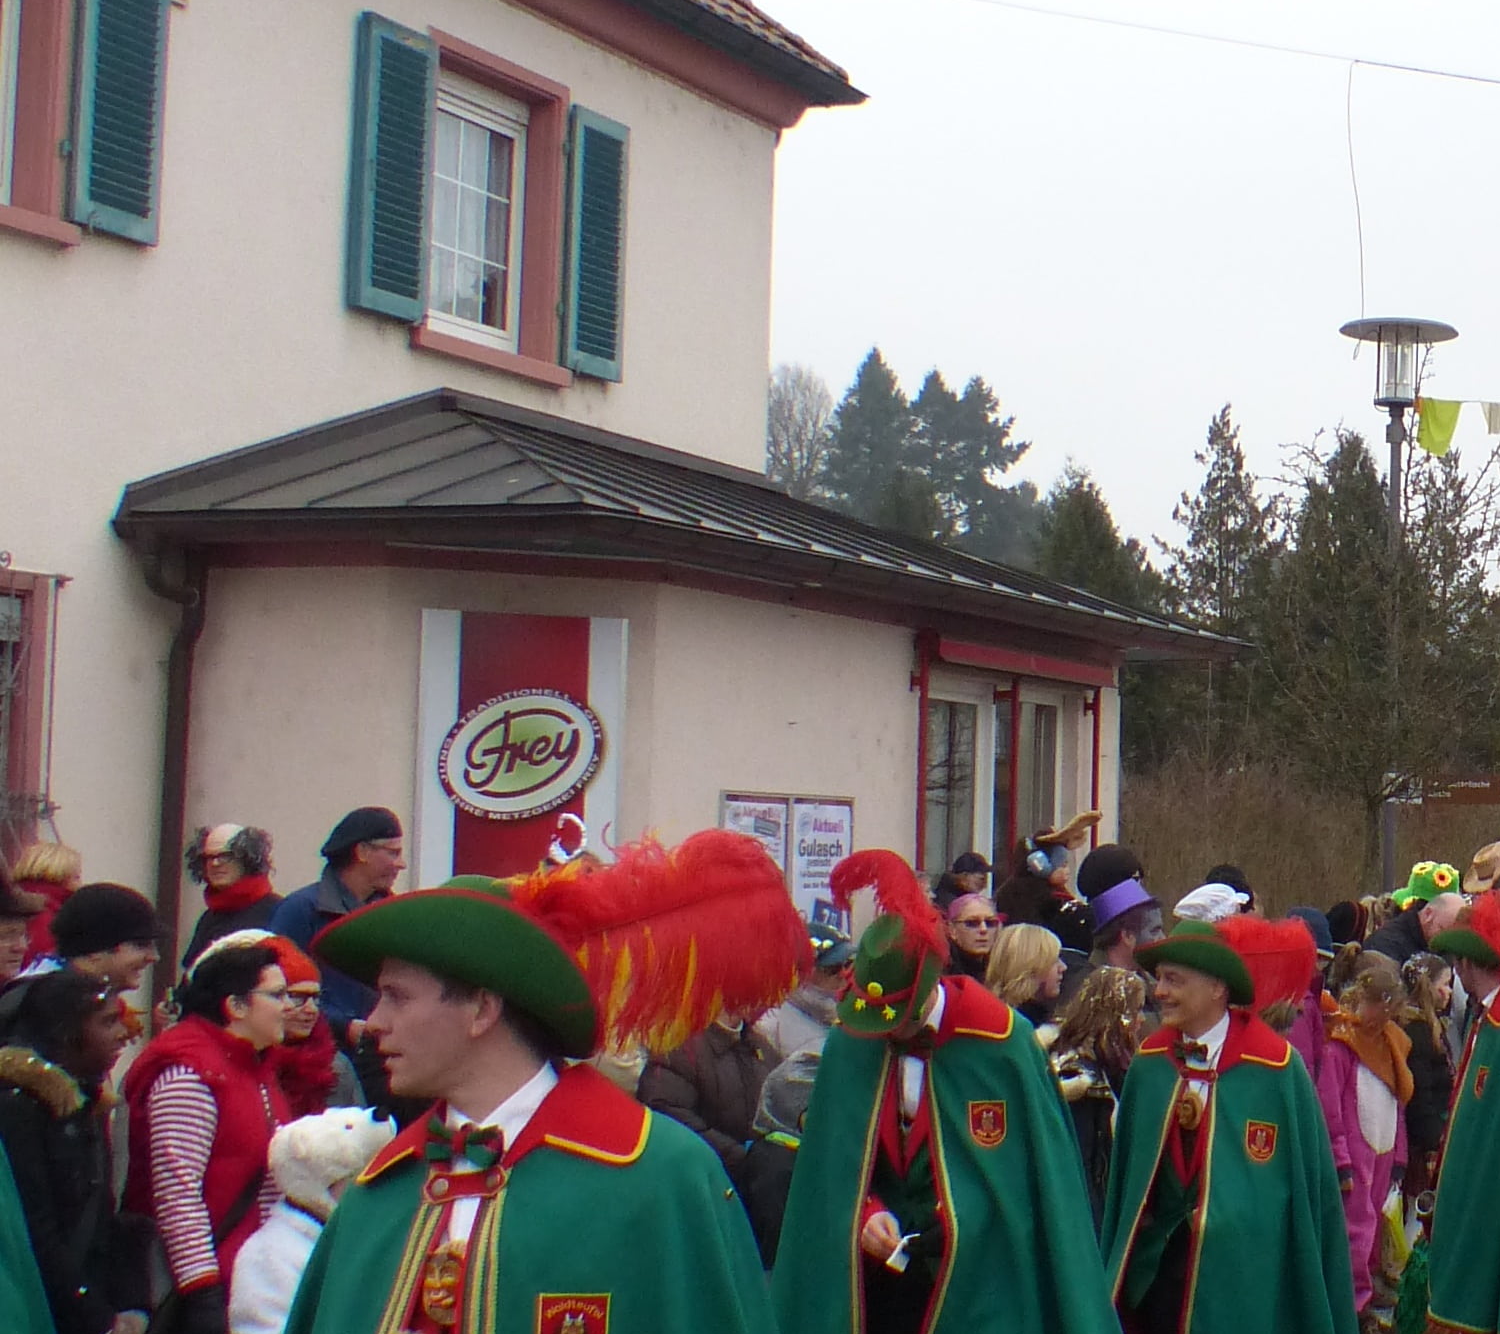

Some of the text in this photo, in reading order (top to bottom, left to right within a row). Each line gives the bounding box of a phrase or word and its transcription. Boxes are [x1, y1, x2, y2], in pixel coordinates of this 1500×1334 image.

[439, 688, 602, 783] JUNG TRADITIONELL GUT
[463, 708, 582, 800] Frey
[450, 754, 600, 820] IHRE METZGEREI FREY
[798, 838, 843, 857] Gulasch
[812, 818, 845, 834] Aktuell
